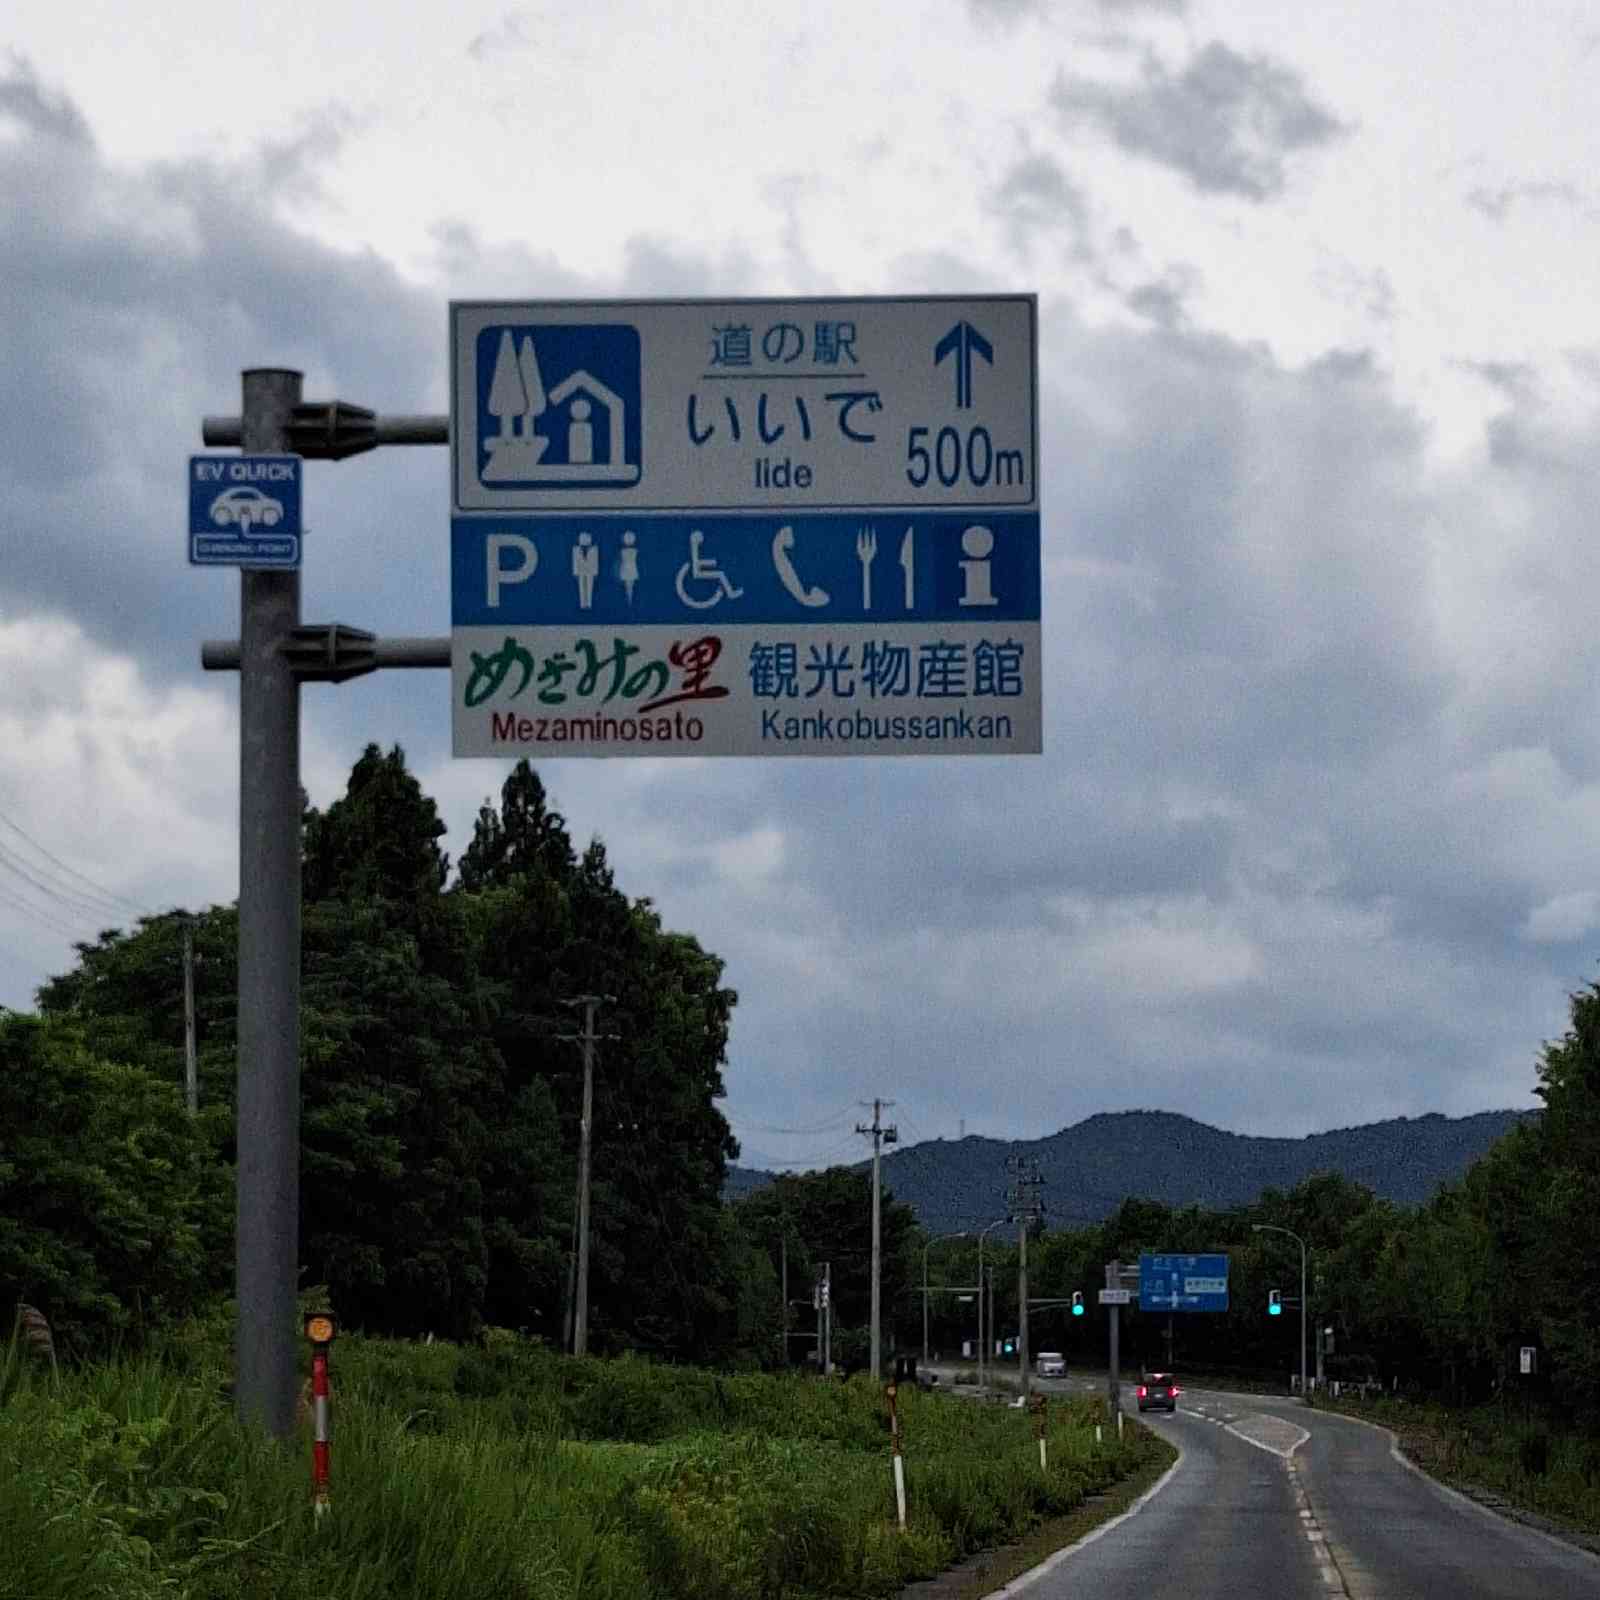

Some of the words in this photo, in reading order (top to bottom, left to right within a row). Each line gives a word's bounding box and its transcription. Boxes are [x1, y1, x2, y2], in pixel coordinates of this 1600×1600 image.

[711, 321, 859, 366] 道の駅
[687, 393, 883, 446] いいで
[196, 463, 225, 480] EV
[230, 463, 295, 480] QUICK
[755, 456, 812, 488] Iide
[905, 426, 1025, 488] 500m
[464, 636, 730, 713] めざみの里
[750, 638, 1024, 700] 観光物産館
[491, 711, 704, 743] Mezaminosato
[762, 708, 1012, 741] Kankobussankan
